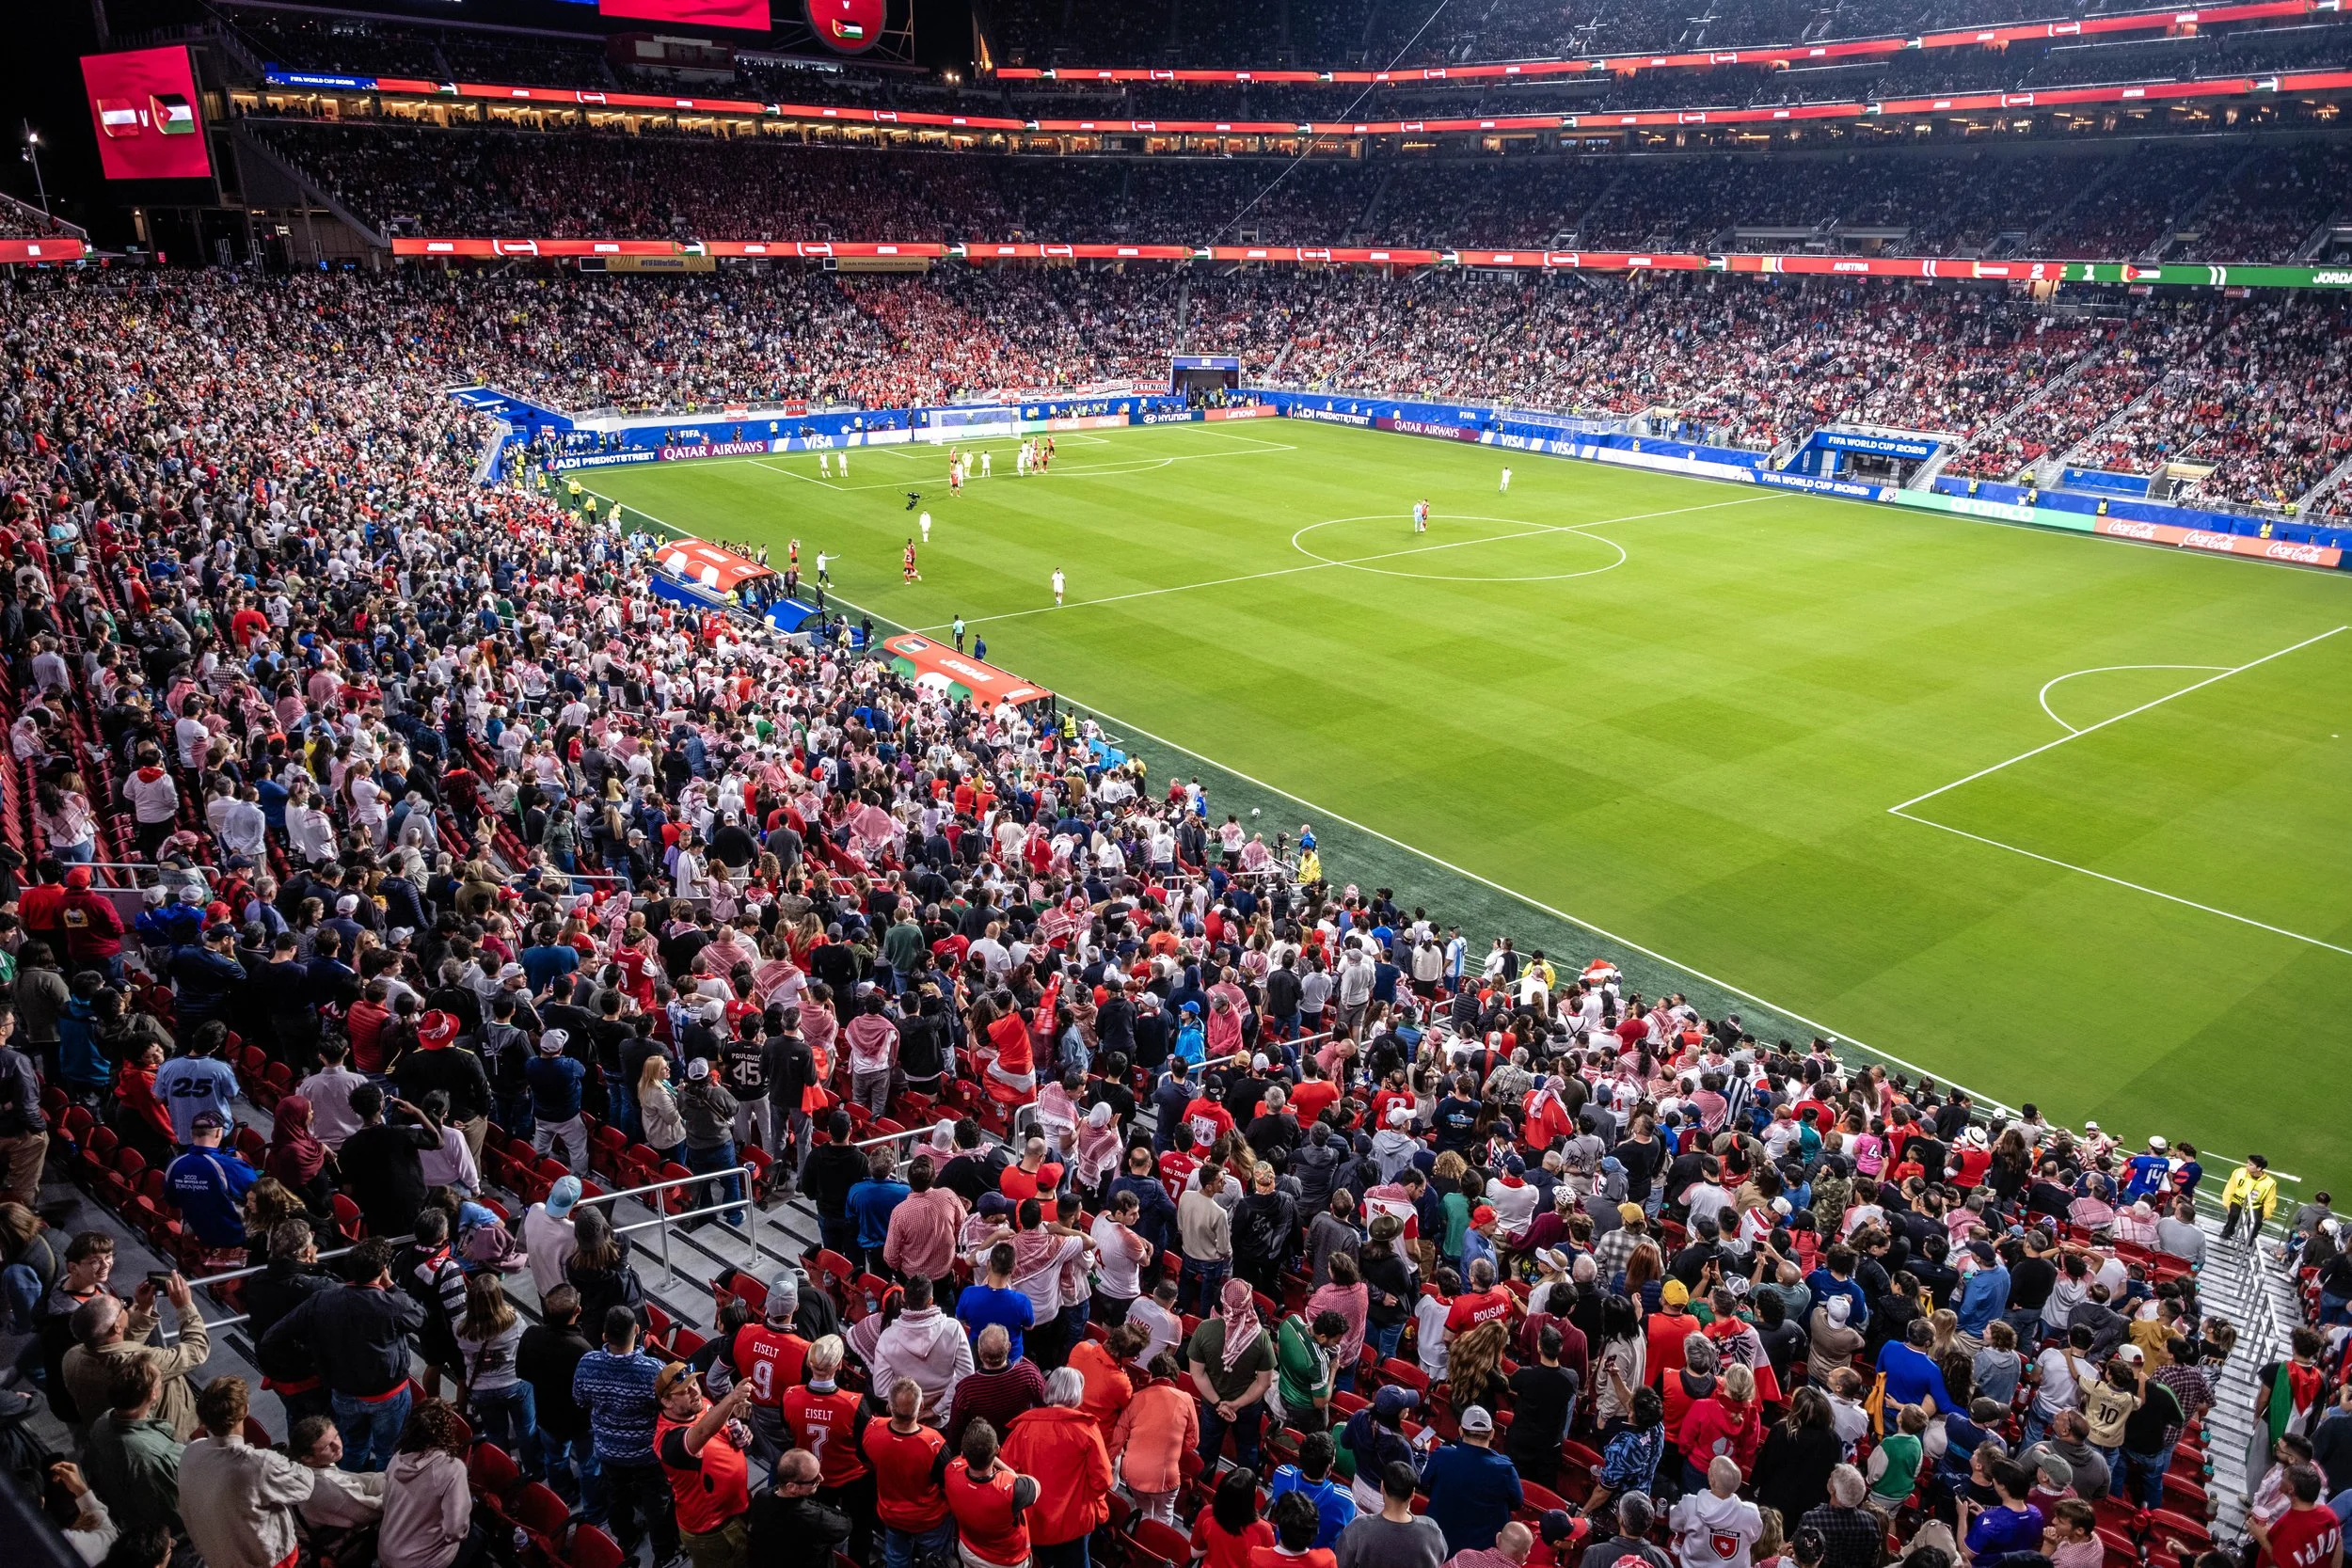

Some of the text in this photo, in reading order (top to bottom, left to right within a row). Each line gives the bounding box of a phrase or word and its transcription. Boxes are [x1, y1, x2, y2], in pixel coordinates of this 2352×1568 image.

[843, 1, 850, 9] V
[139, 109, 149, 127] V
[641, 260, 684, 268] #FIFAWorldCup
[1833, 261, 1869, 272] AUSTRIA
[2030, 263, 2045, 279] 2
[2082, 264, 2095, 280] 1
[1157, 413, 1192, 422] HYUNDAI
[1225, 408, 1257, 420] Lenovo
[1459, 411, 1476, 420] FIFA
[680, 429, 700, 438] FIFA
[1394, 419, 1460, 438] QATAR AIRWAYS
[663, 440, 765, 461] QATAR AIRWAYS
[801, 436, 834, 450] VISA
[1500, 434, 1576, 457] VISA VISA
[1828, 436, 1928, 455] FIFA WORLD CUP 2026
[555, 456, 581, 469] ADI
[1762, 472, 1783, 484] FIFA
[1783, 475, 1814, 488] WORLD
[1814, 480, 1835, 491] CUP
[1950, 497, 2035, 521] aramco
[732, 1060, 762, 1086] 45
[172, 1077, 213, 1098] 25
[1867, 1144, 1879, 1159] 4
[1162, 1165, 1174, 1175] ABU
[2145, 1168, 2163, 1185] 14
[1168, 1178, 1182, 1199] 7
[1473, 1302, 1506, 1323] ROUSAN
[753, 1341, 780, 1359] EISELT
[753, 1359, 774, 1402] 9
[805, 1407, 834, 1422] EISELT
[2098, 1402, 2120, 1426] 10
[806, 1422, 831, 1463] 7
